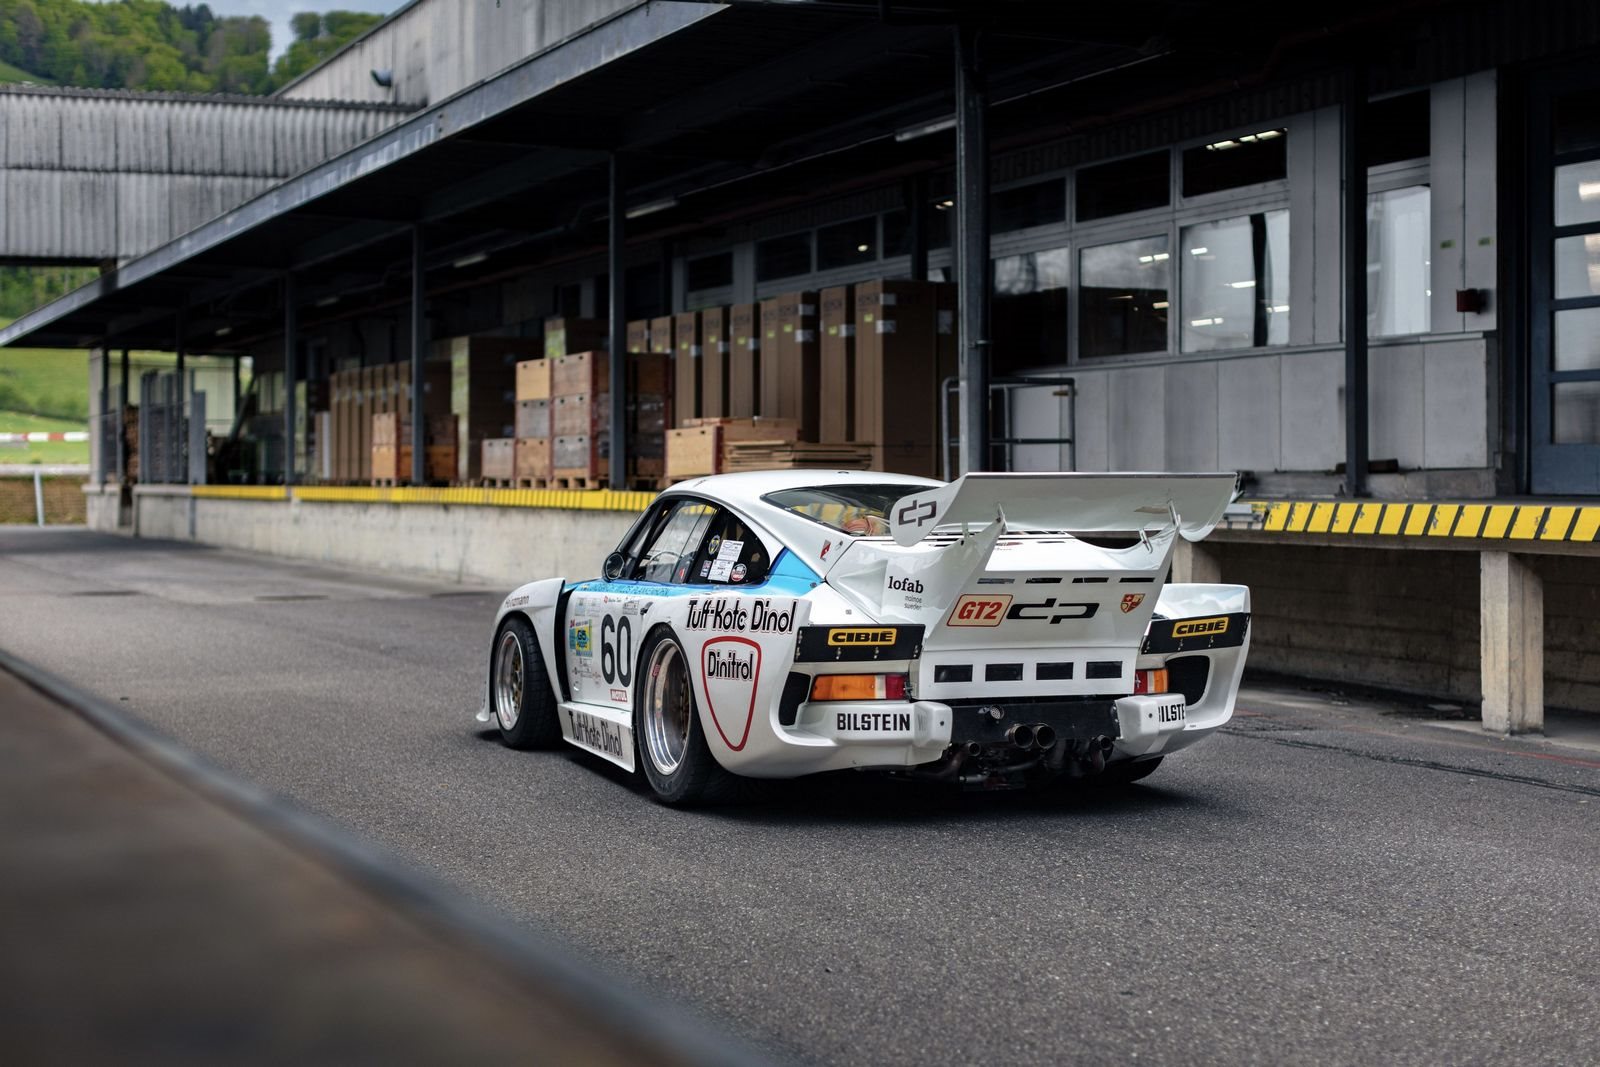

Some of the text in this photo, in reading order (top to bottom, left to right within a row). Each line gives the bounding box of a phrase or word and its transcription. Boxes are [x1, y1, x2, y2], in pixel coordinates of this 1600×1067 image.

[888, 576, 924, 594] lofab
[750, 598, 797, 633] Dinol
[957, 601, 1003, 620] GT2
[601, 613, 632, 688] 60
[707, 650, 754, 680] Dinitrol
[836, 713, 911, 731] BILSTEIN
